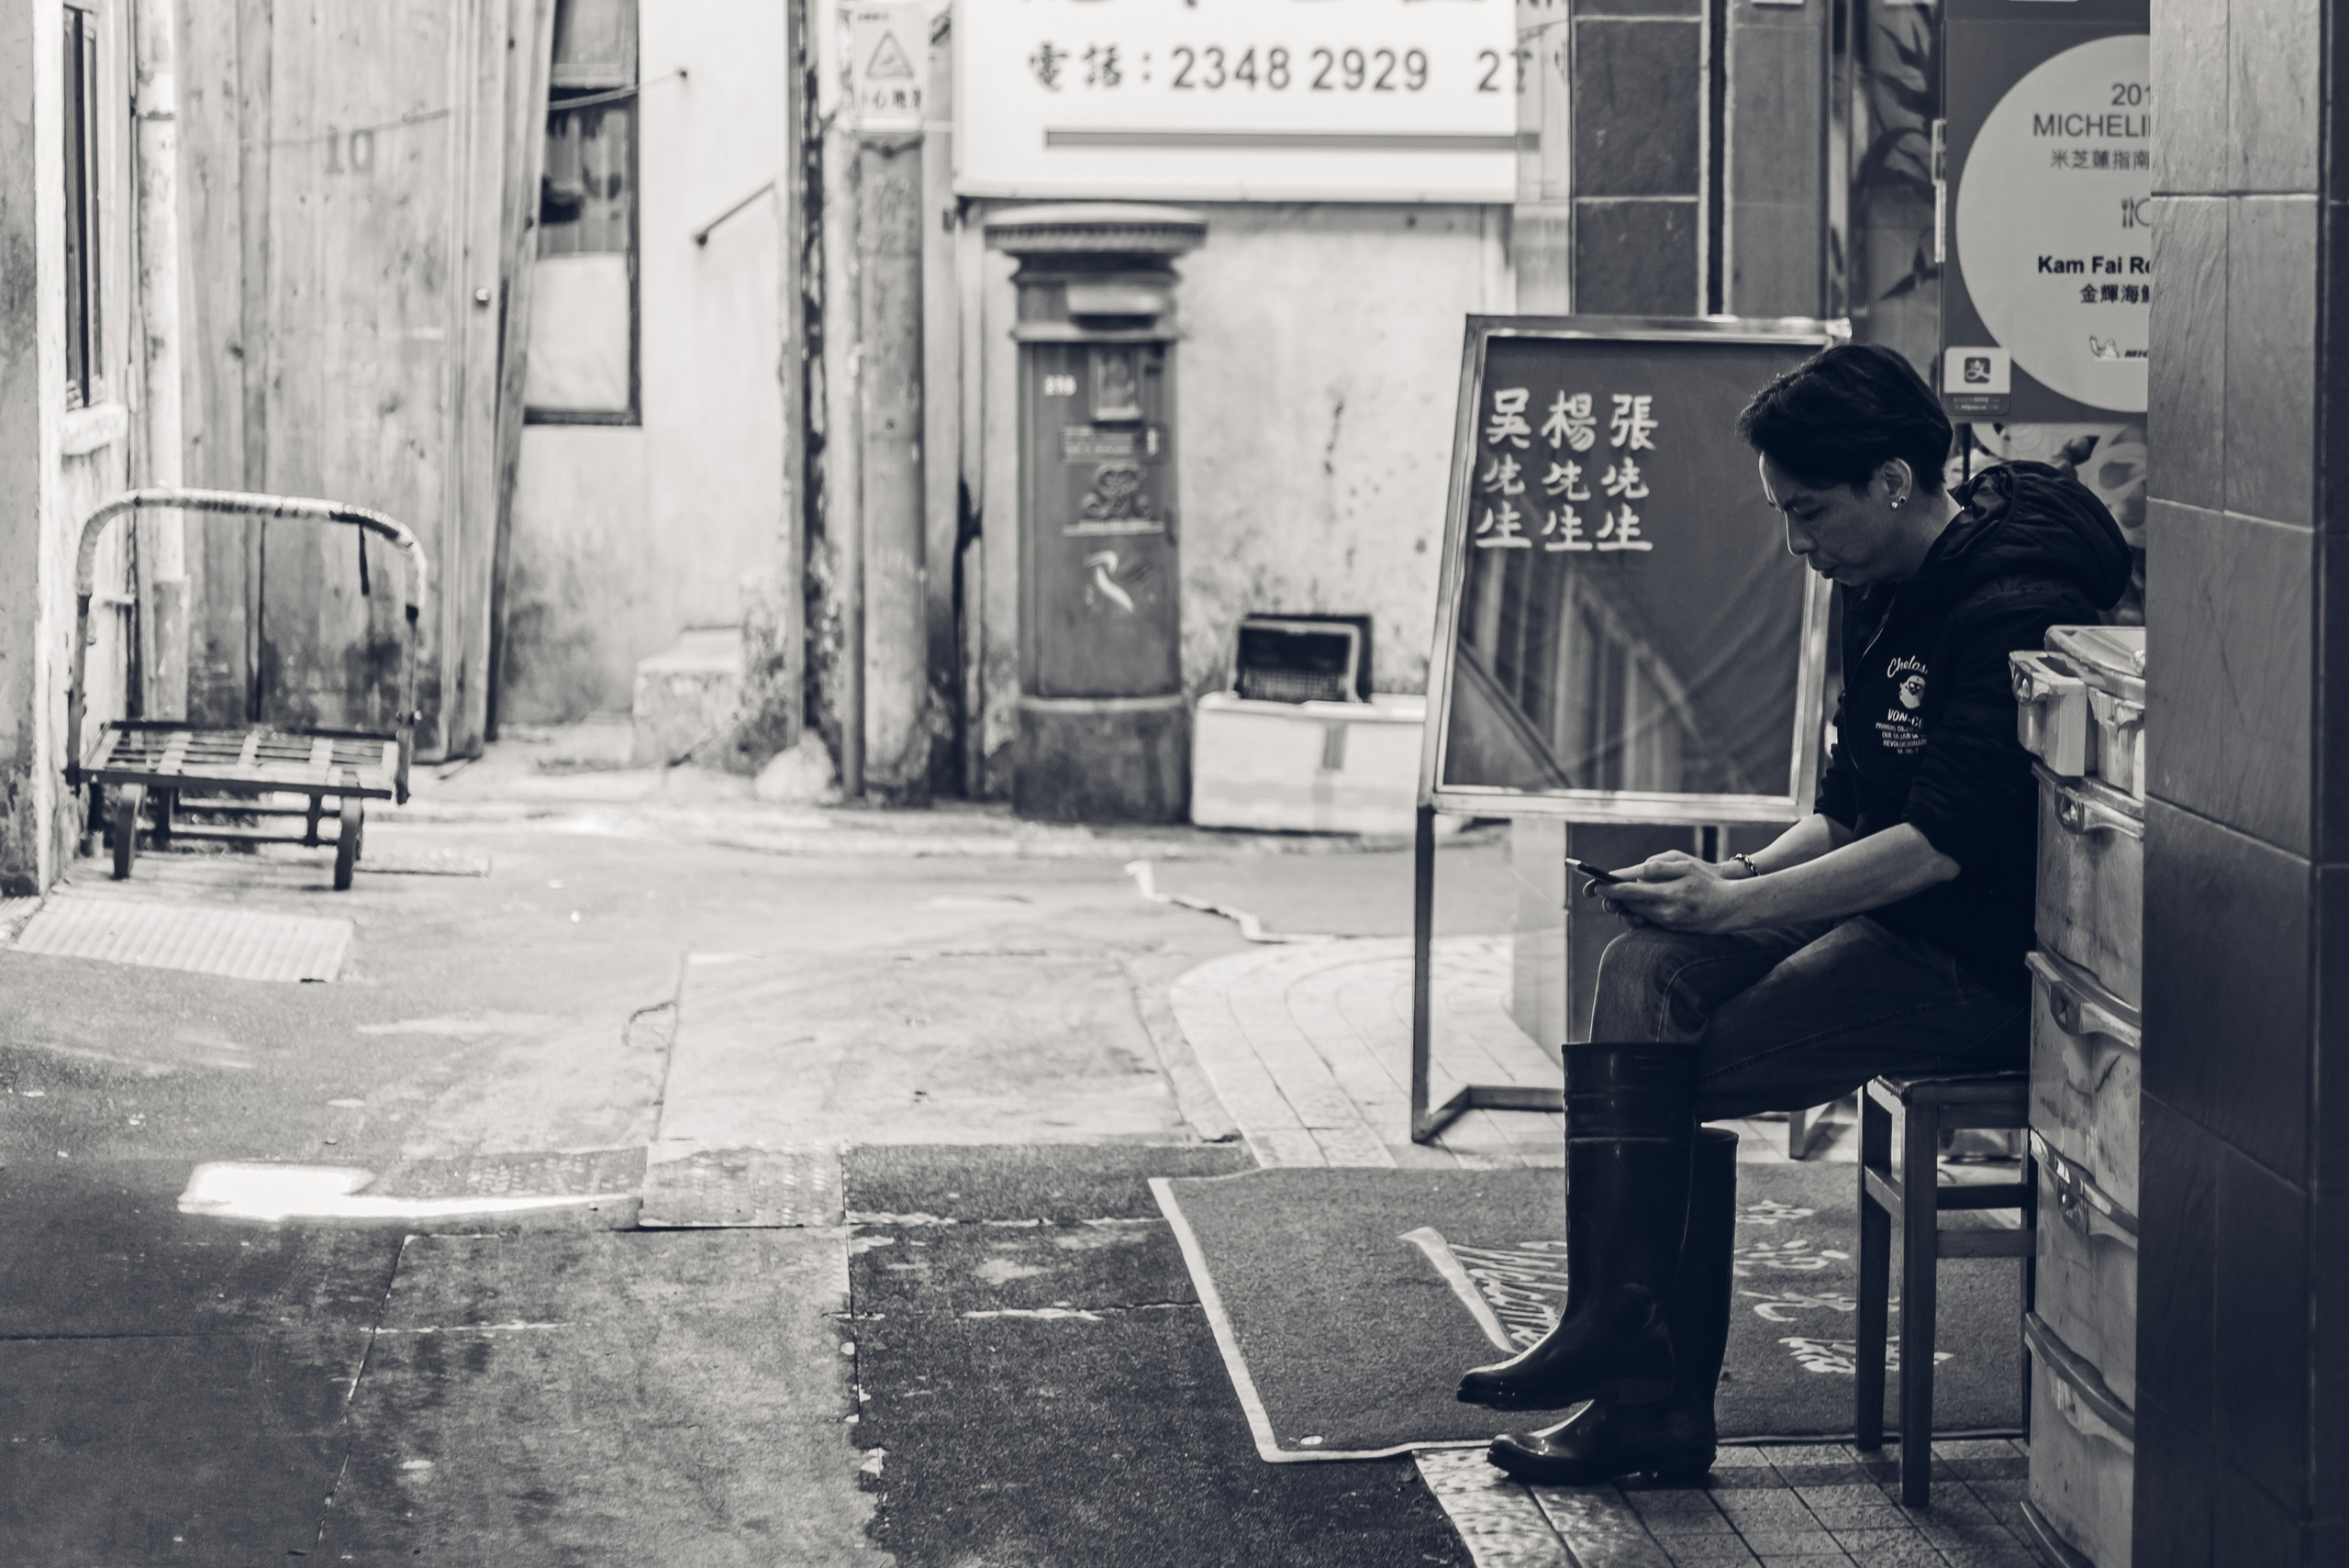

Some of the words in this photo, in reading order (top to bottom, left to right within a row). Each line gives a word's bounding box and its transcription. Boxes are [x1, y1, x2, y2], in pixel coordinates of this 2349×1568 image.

[1172, 47, 1291, 90] 2348
[1311, 49, 1430, 91] 2929
[2033, 114, 2151, 138] MICHELI
[2038, 256, 2085, 274] Kam
[2092, 256, 2122, 274] Fai
